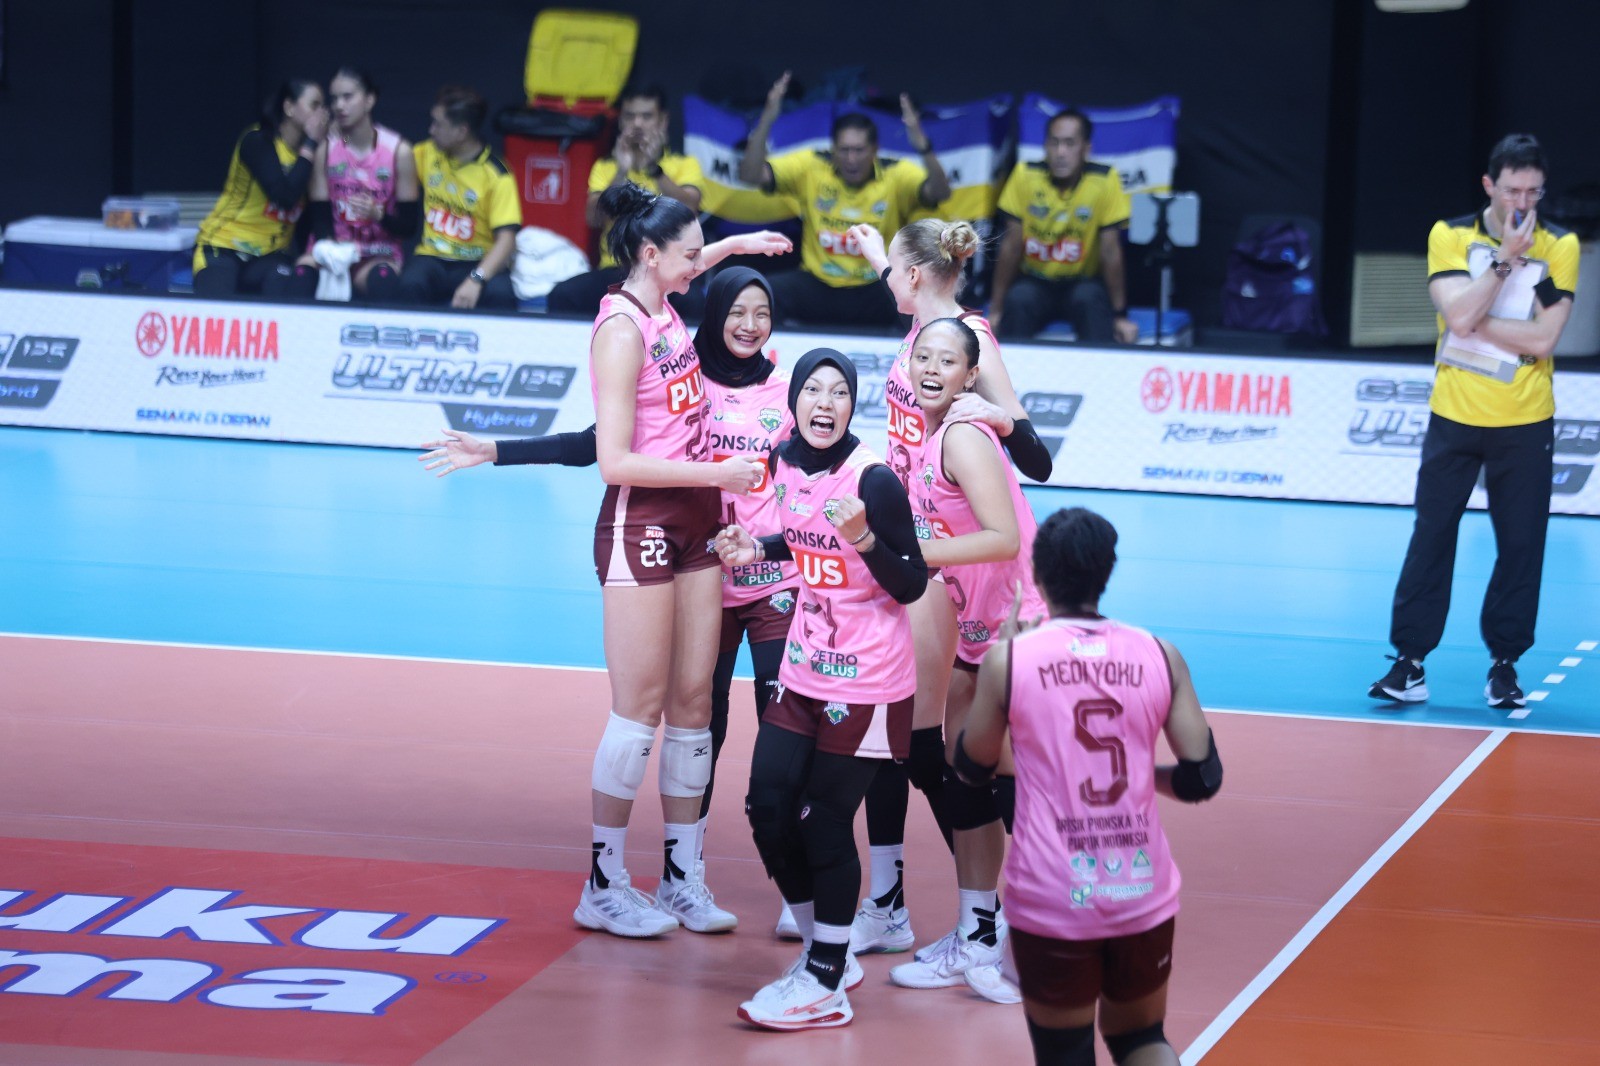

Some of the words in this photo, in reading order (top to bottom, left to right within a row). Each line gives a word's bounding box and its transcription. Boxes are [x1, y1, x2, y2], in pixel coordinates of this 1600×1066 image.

[1025, 238, 1081, 262] PLUS
[171, 315, 279, 361] YAMAHA
[340, 324, 479, 352] GEAR
[23, 340, 67, 359] 125
[659, 343, 695, 378] PHONS
[332, 353, 512, 397] ULTIMA
[519, 368, 567, 392] 125
[1178, 371, 1291, 416] YAMAHA
[137, 407, 199, 423] SEMAKIN
[204, 411, 217, 424] DI
[221, 413, 271, 427] DEPAN
[463, 409, 538, 429] Hybrid
[1142, 466, 1208, 481] SEMAKIN
[1213, 471, 1227, 482] DI
[1232, 472, 1283, 485] DEPAN
[646, 530, 664, 538] PLUS
[640, 539, 668, 567] 22
[731, 561, 781, 575] PETRO
[811, 650, 858, 666] PETRO
[1073, 698, 1129, 808] 5
[1087, 814, 1132, 831] PHONSKA
[1101, 831, 1148, 849] INDONESIA
